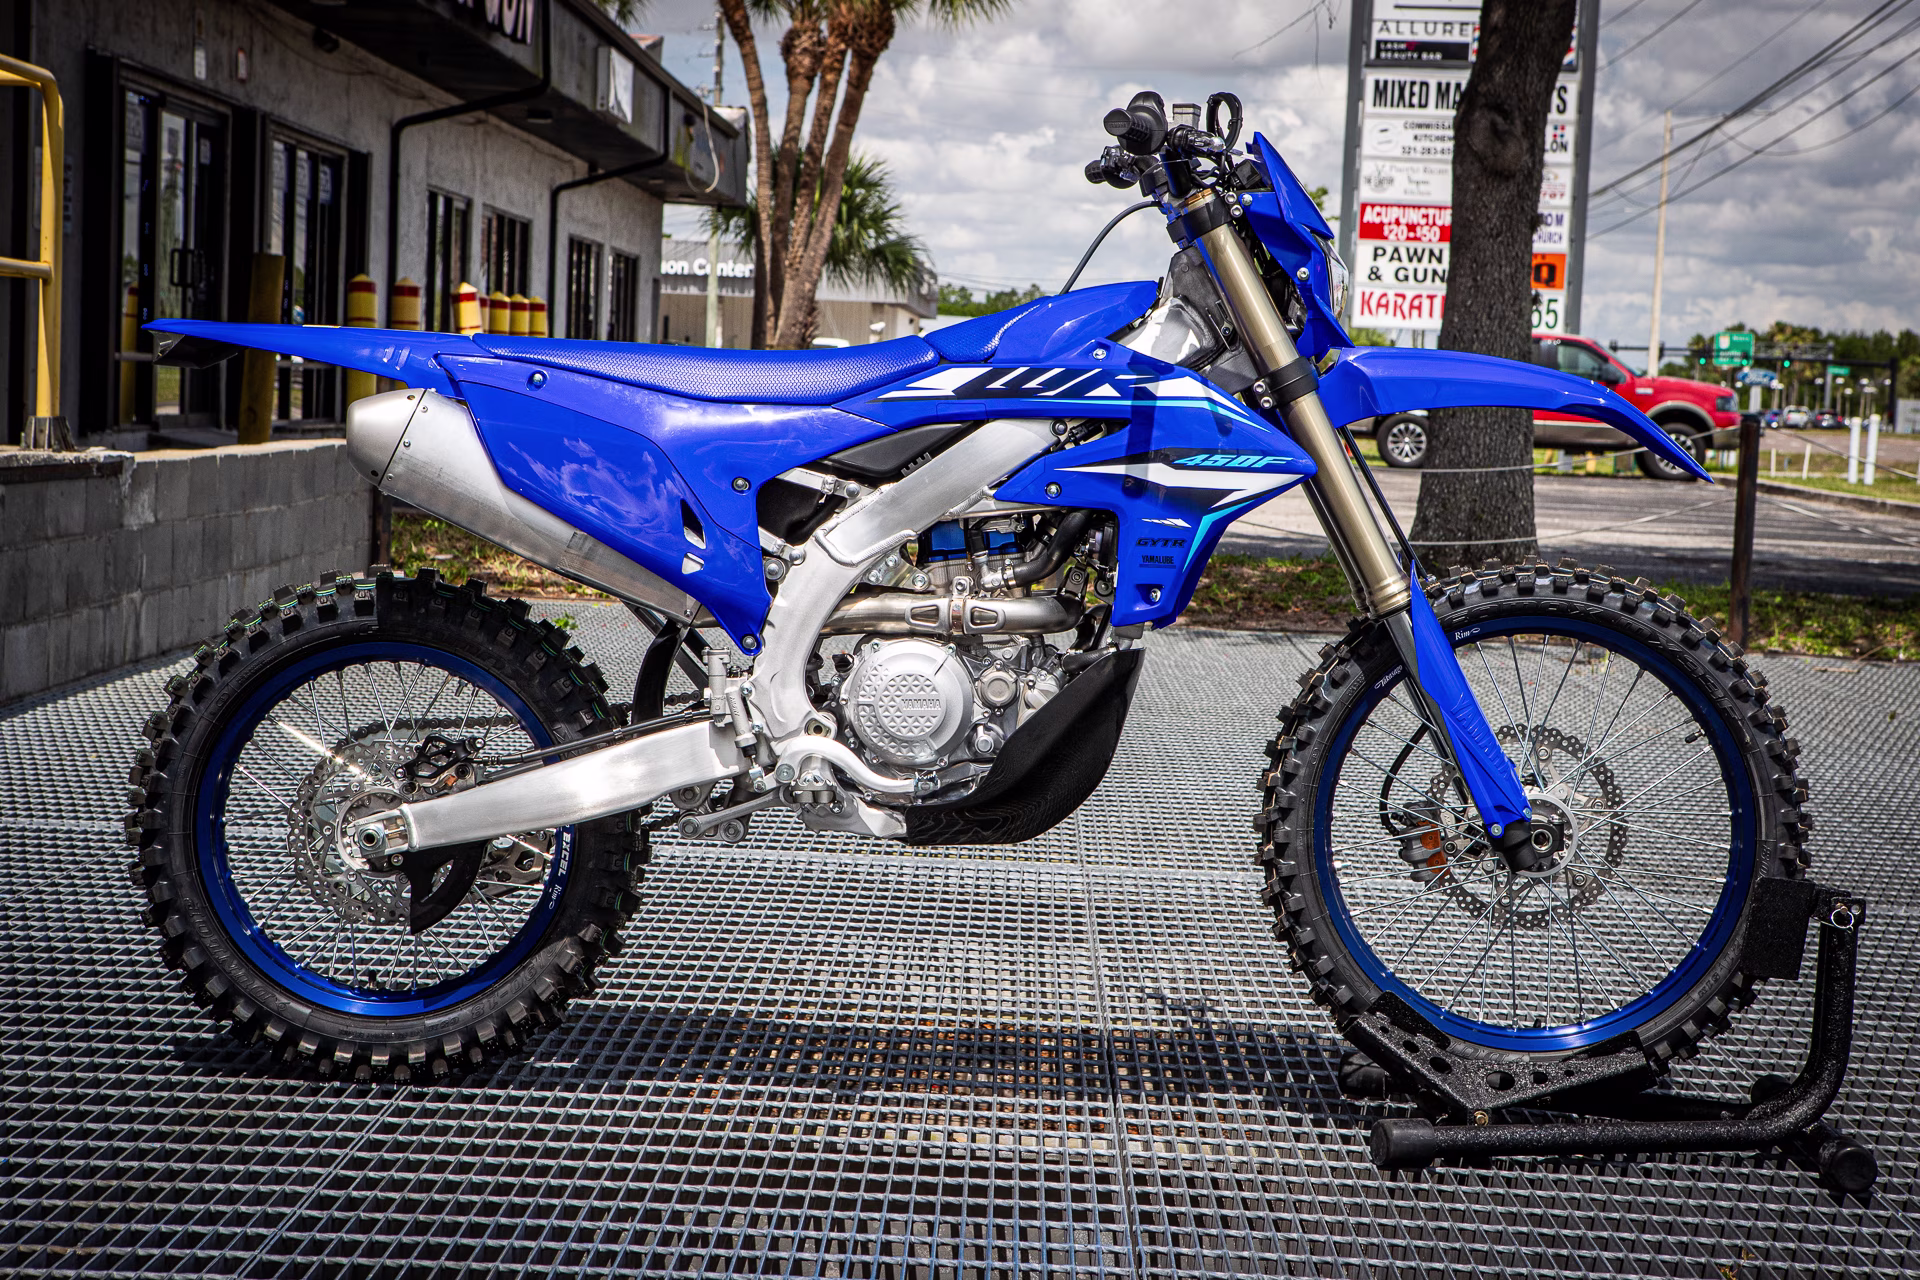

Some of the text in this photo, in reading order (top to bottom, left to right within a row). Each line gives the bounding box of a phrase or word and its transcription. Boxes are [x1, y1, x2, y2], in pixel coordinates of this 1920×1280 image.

[1378, 20, 1470, 37] ALLURE
[1373, 79, 1429, 108] MIXED
[1403, 120, 1452, 130] COMMISSA
[1362, 205, 1452, 226] ACUPUNCTUR
[1383, 224, 1441, 242] $20-$50
[1373, 246, 1443, 264] PAWN
[1367, 266, 1447, 283] & GUN
[1172, 454, 1294, 468] 450F
[1136, 537, 1187, 549] GYTR
[1142, 555, 1175, 565] YAMALUBE
[901, 698, 942, 710] YAMAHA
[558, 831, 571, 876] EXCEL
